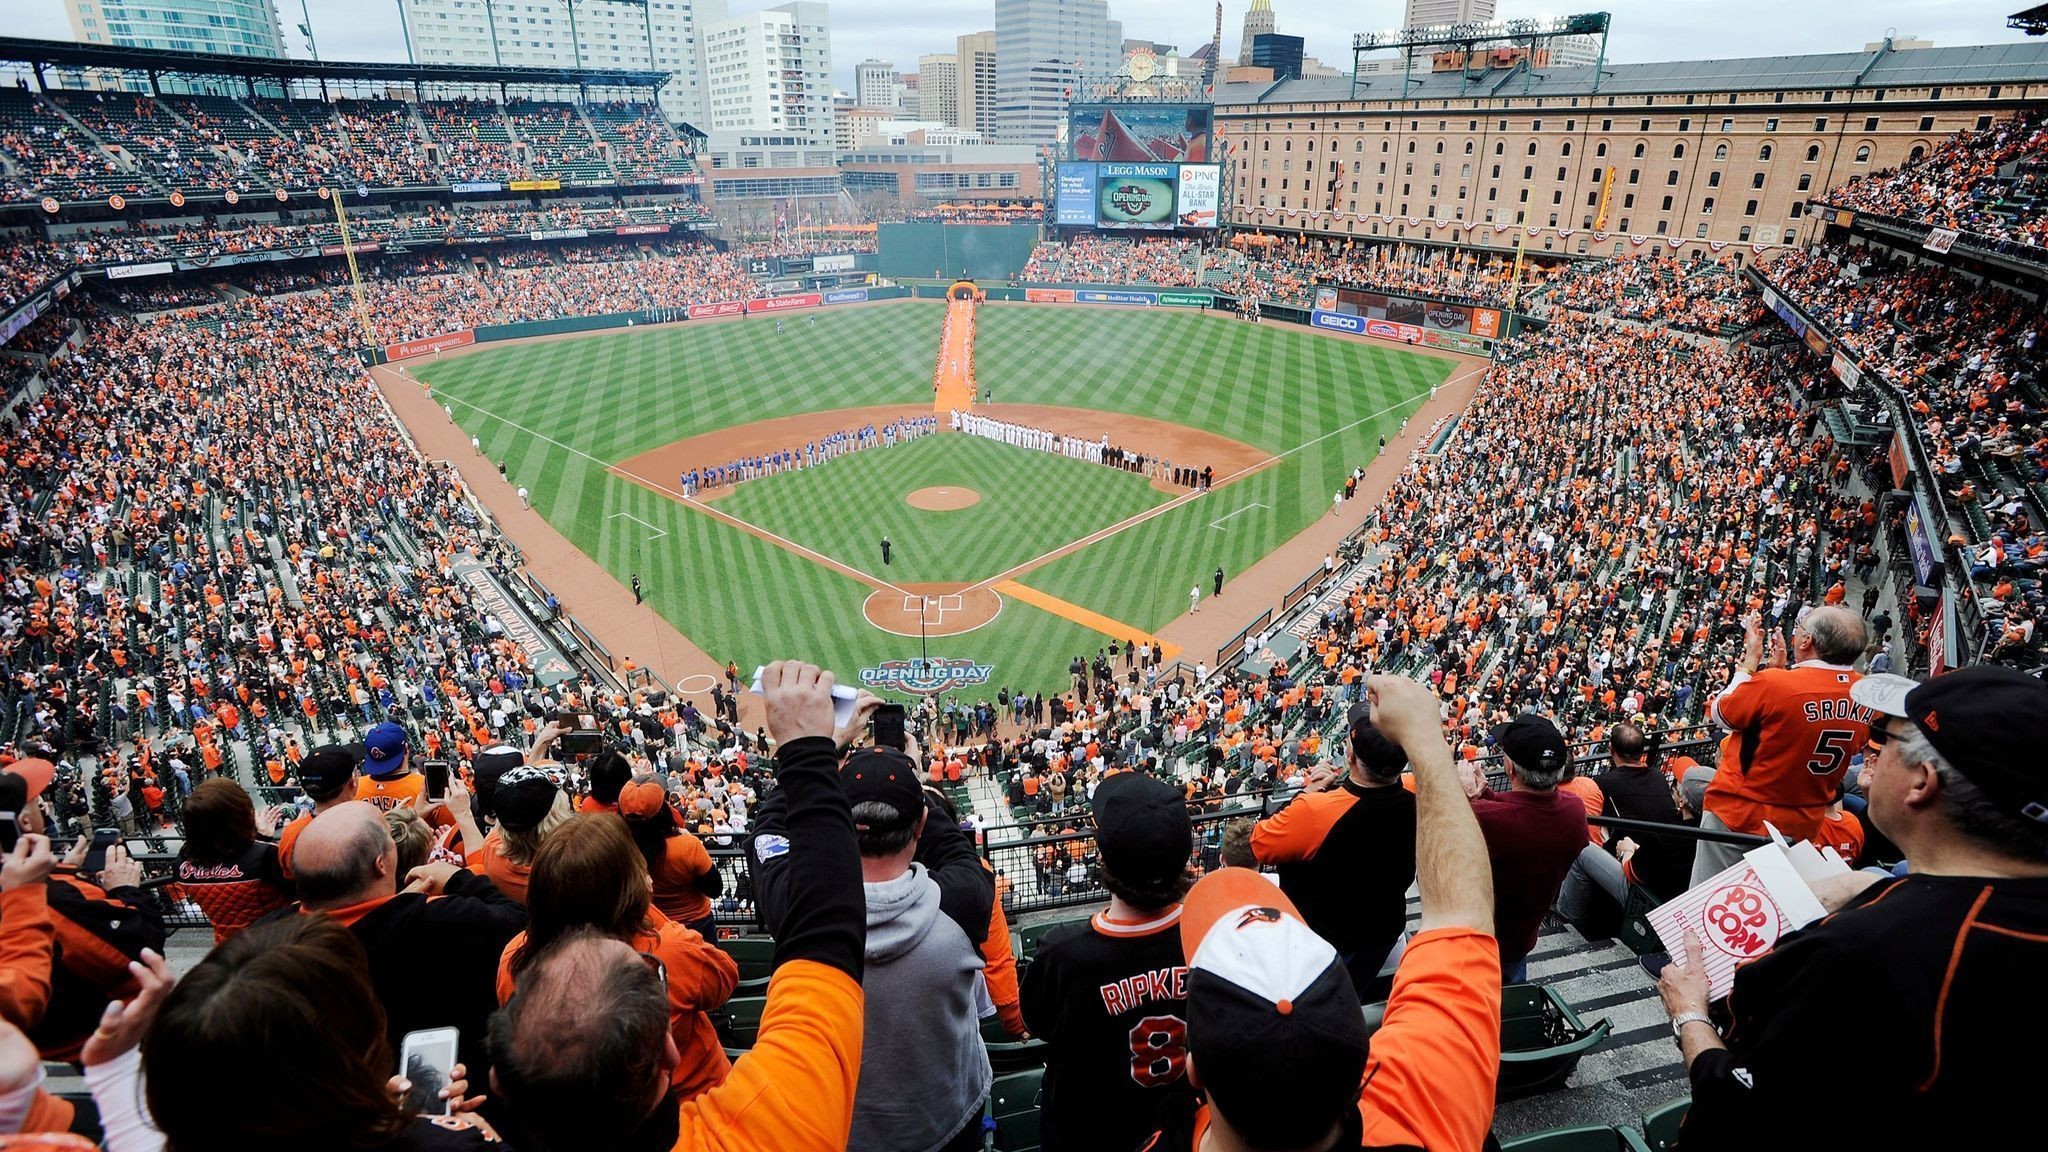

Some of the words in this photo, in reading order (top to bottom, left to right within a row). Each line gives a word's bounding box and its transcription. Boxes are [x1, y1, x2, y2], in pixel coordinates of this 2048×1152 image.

[1108, 165, 1132, 175] LEGG
[1134, 165, 1168, 176] MASON
[1195, 171, 1217, 180] PNC
[1189, 199, 1207, 207] BANK
[828, 292, 859, 302] Southwest
[1321, 314, 1358, 330] GEICO
[951, 666, 990, 679] DAY
[1806, 729, 1856, 776] 5
[179, 860, 244, 879] Orioles
[1724, 886, 1768, 929] POP
[1707, 903, 1767, 955] CORN
[1128, 1014, 1188, 1088] 8
